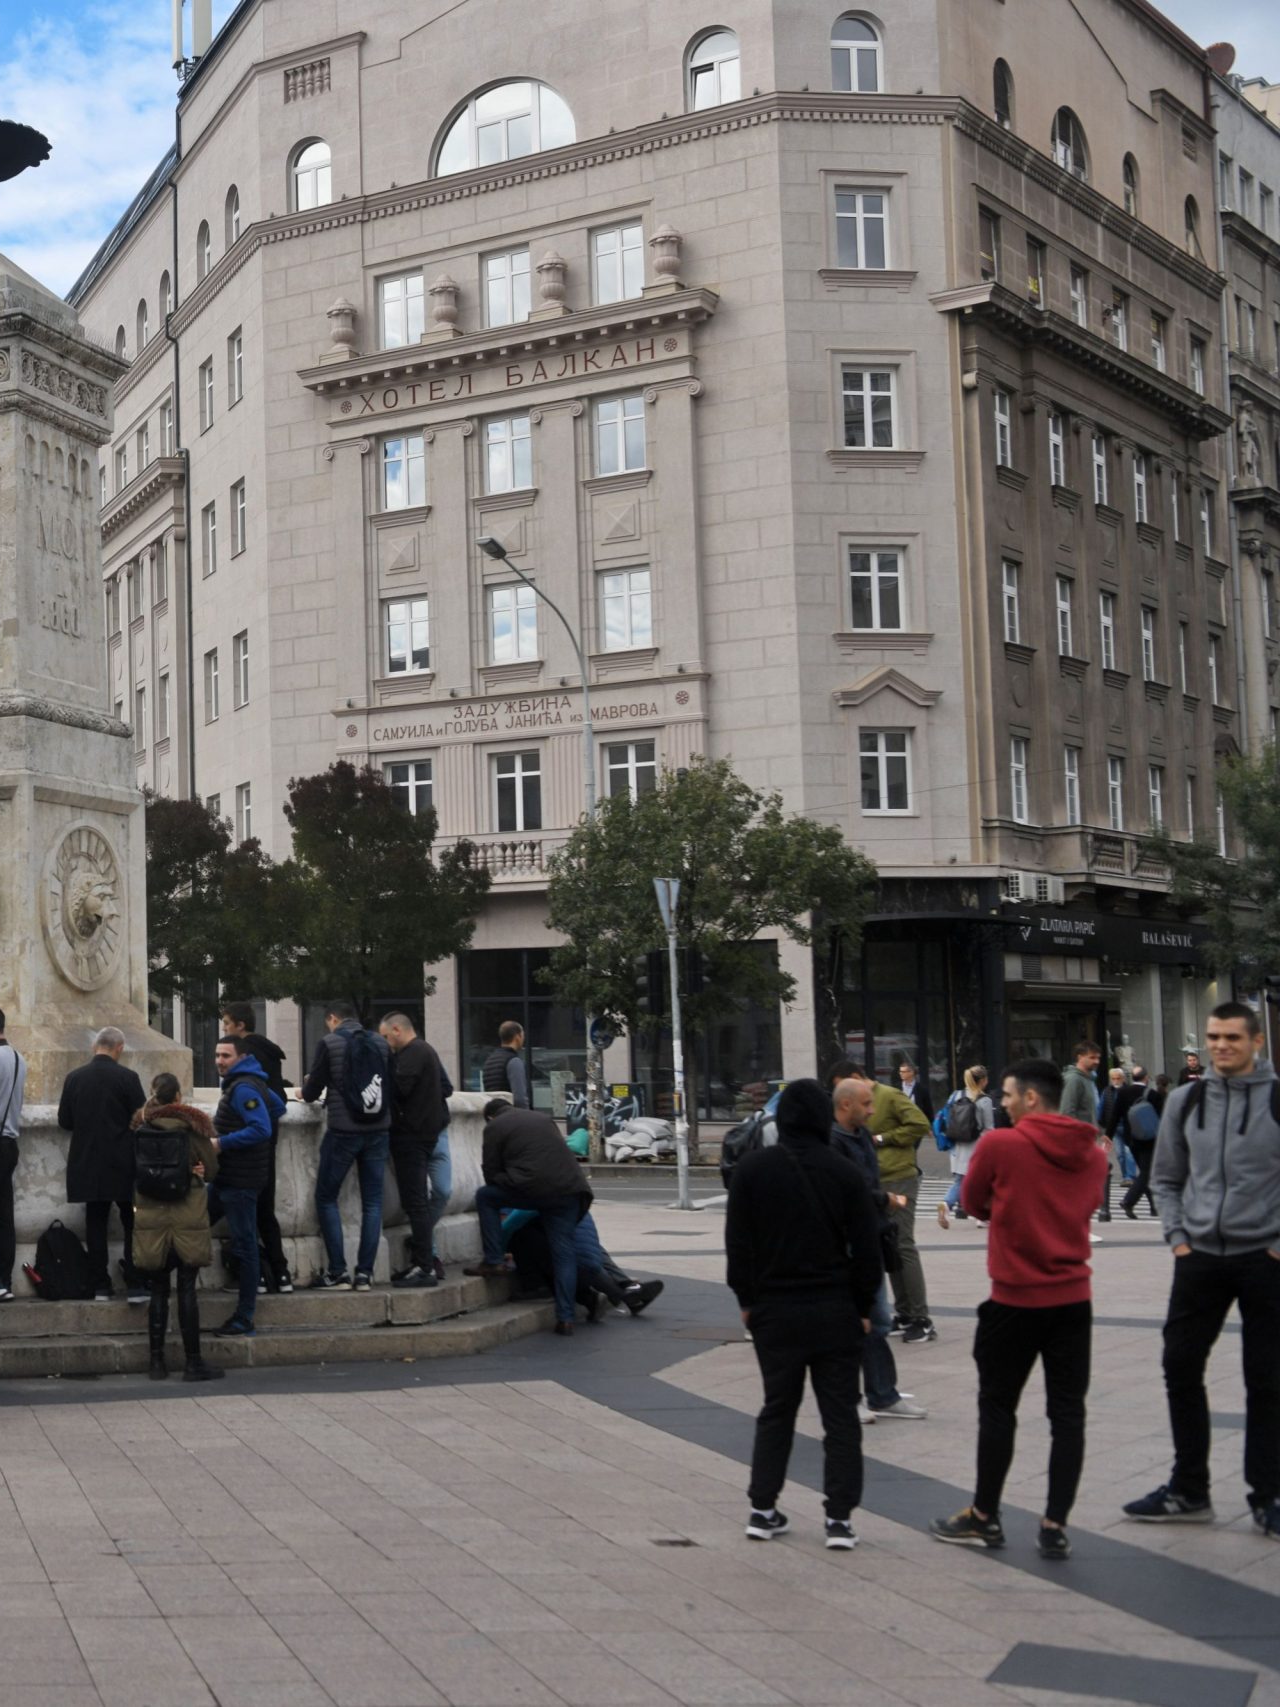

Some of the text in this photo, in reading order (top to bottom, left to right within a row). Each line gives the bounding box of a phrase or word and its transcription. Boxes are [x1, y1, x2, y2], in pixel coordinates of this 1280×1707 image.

[359, 337, 656, 415] ХОТЕЛ БАЛКАН
[453, 695, 572, 719] ЗАДУЖБИНА
[373, 724, 434, 742] САМУИЛА
[444, 718, 498, 735] ГОЛУБА
[505, 711, 563, 729] ЈАНИЋА
[590, 702, 659, 721] МАВРОВА
[1040, 917, 1074, 933] ZLATARA
[1141, 930, 1193, 948] BALAŠEVIĆ
[360, 1073, 383, 1107] NIKE
